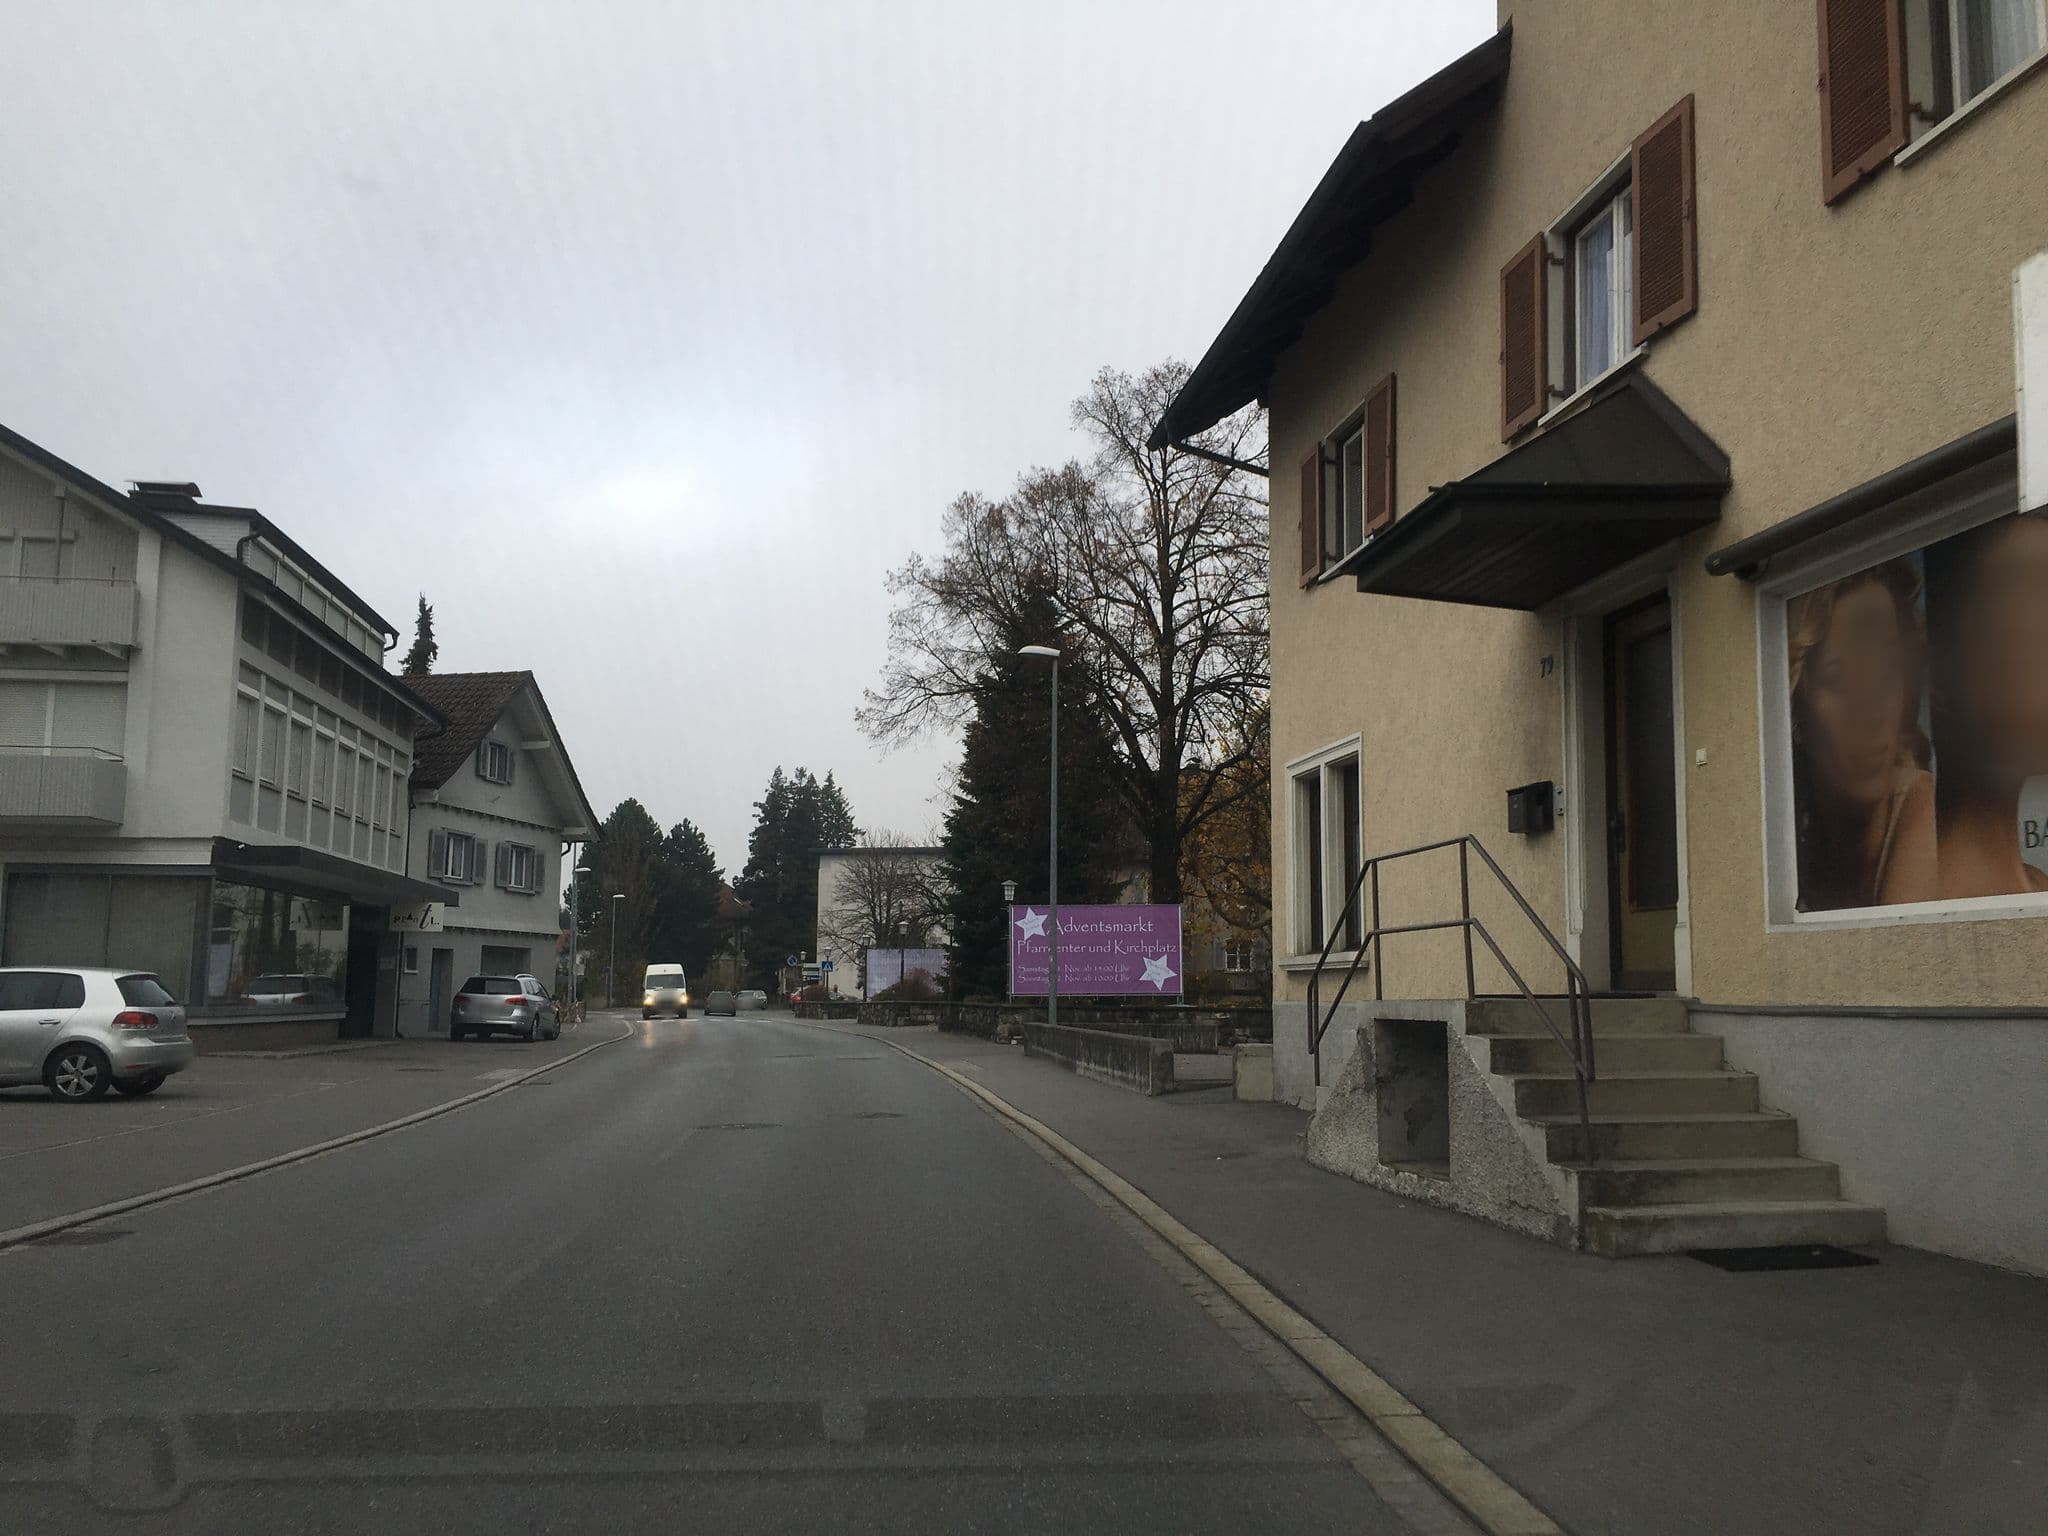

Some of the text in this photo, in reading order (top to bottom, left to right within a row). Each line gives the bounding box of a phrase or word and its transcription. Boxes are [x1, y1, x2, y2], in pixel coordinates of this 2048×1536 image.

[1017, 940, 1177, 958] Pfarrenter und Kirchplatz
